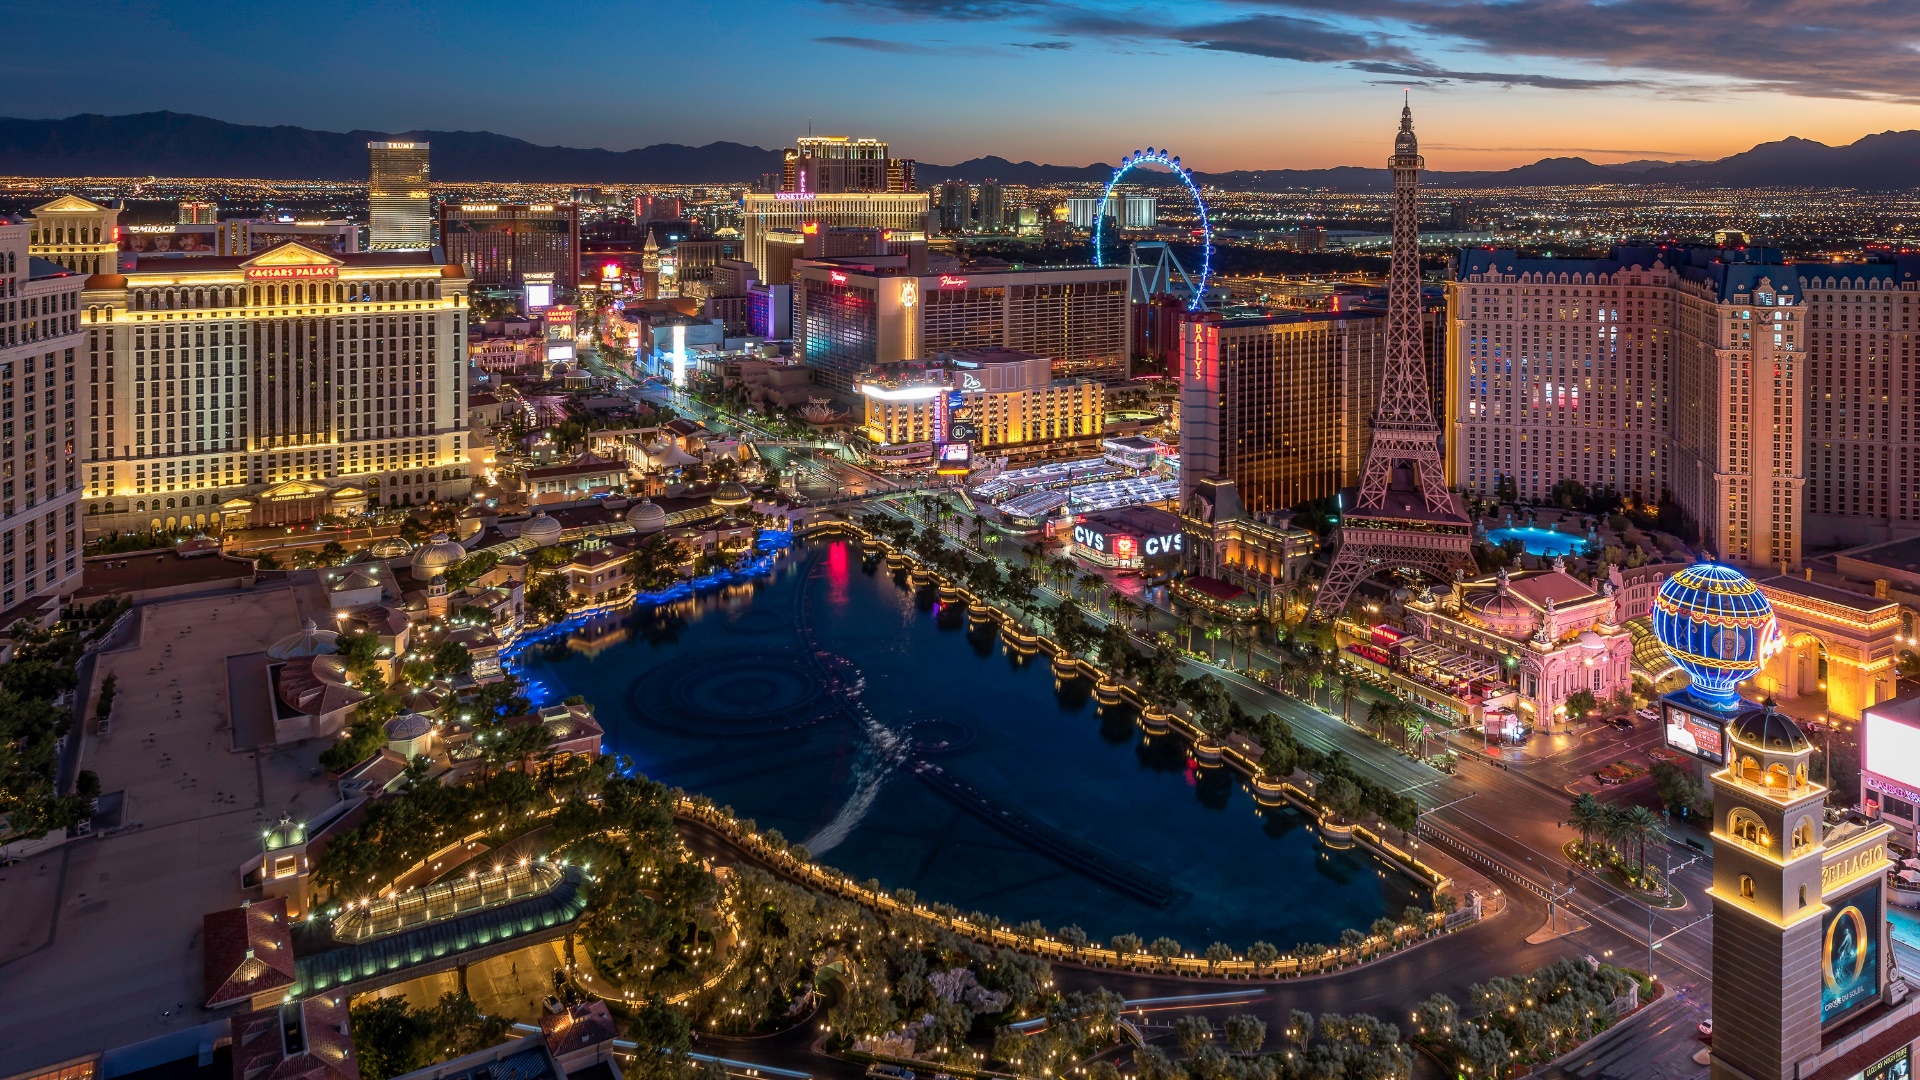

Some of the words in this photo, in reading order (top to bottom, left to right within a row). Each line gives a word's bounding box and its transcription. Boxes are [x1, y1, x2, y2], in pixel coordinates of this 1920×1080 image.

[138, 225, 176, 233] MIRAGE
[248, 269, 293, 278] CAESARS
[296, 267, 335, 277] PALACE
[940, 276, 967, 286] Flamingo
[1074, 525, 1104, 551] CVS
[1145, 533, 1181, 555] CVS
[1371, 626, 1384, 636] BEER
[1384, 631, 1398, 641] PARK
[1822, 844, 1884, 888] BELLAGIO
[1824, 997, 1842, 1012] CIRQUE
[1841, 993, 1849, 1003] DU
[1849, 985, 1865, 998] SOLEIL
